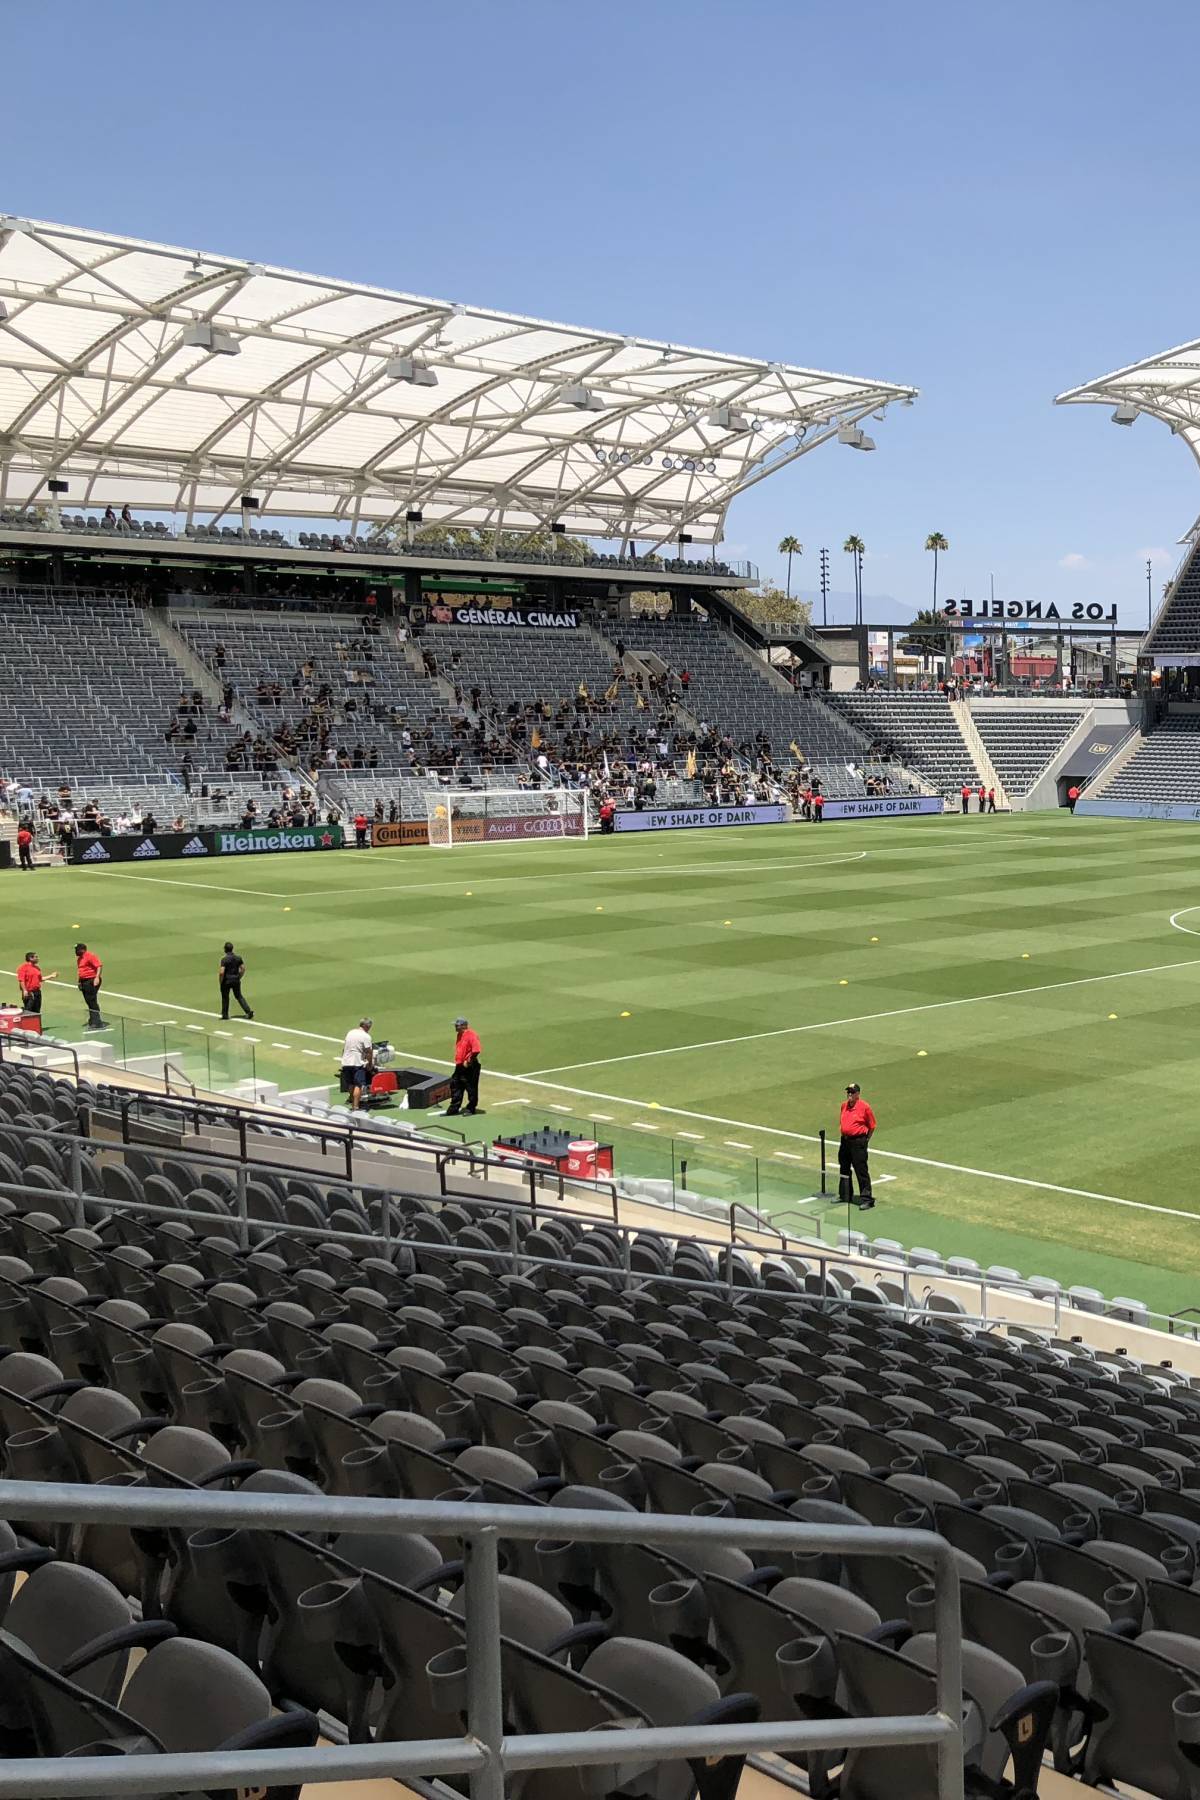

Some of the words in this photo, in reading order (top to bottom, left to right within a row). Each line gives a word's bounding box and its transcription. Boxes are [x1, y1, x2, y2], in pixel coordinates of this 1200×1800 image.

[528, 612, 577, 627] CIMAN
[841, 804, 856, 814] EW
[858, 803, 884, 813] SHAPE
[886, 802, 897, 811] OF
[899, 801, 922, 811] DAIRY
[648, 815, 668, 827] EW
[671, 813, 705, 826] SHAPE
[708, 812, 723, 823] OF
[726, 810, 757, 822] DAIRY
[488, 823, 517, 834] Audi
[220, 831, 316, 852] Heineken
[82, 852, 111, 860] adidas
[133, 849, 161, 857] adidas
[182, 847, 208, 855] adidas
